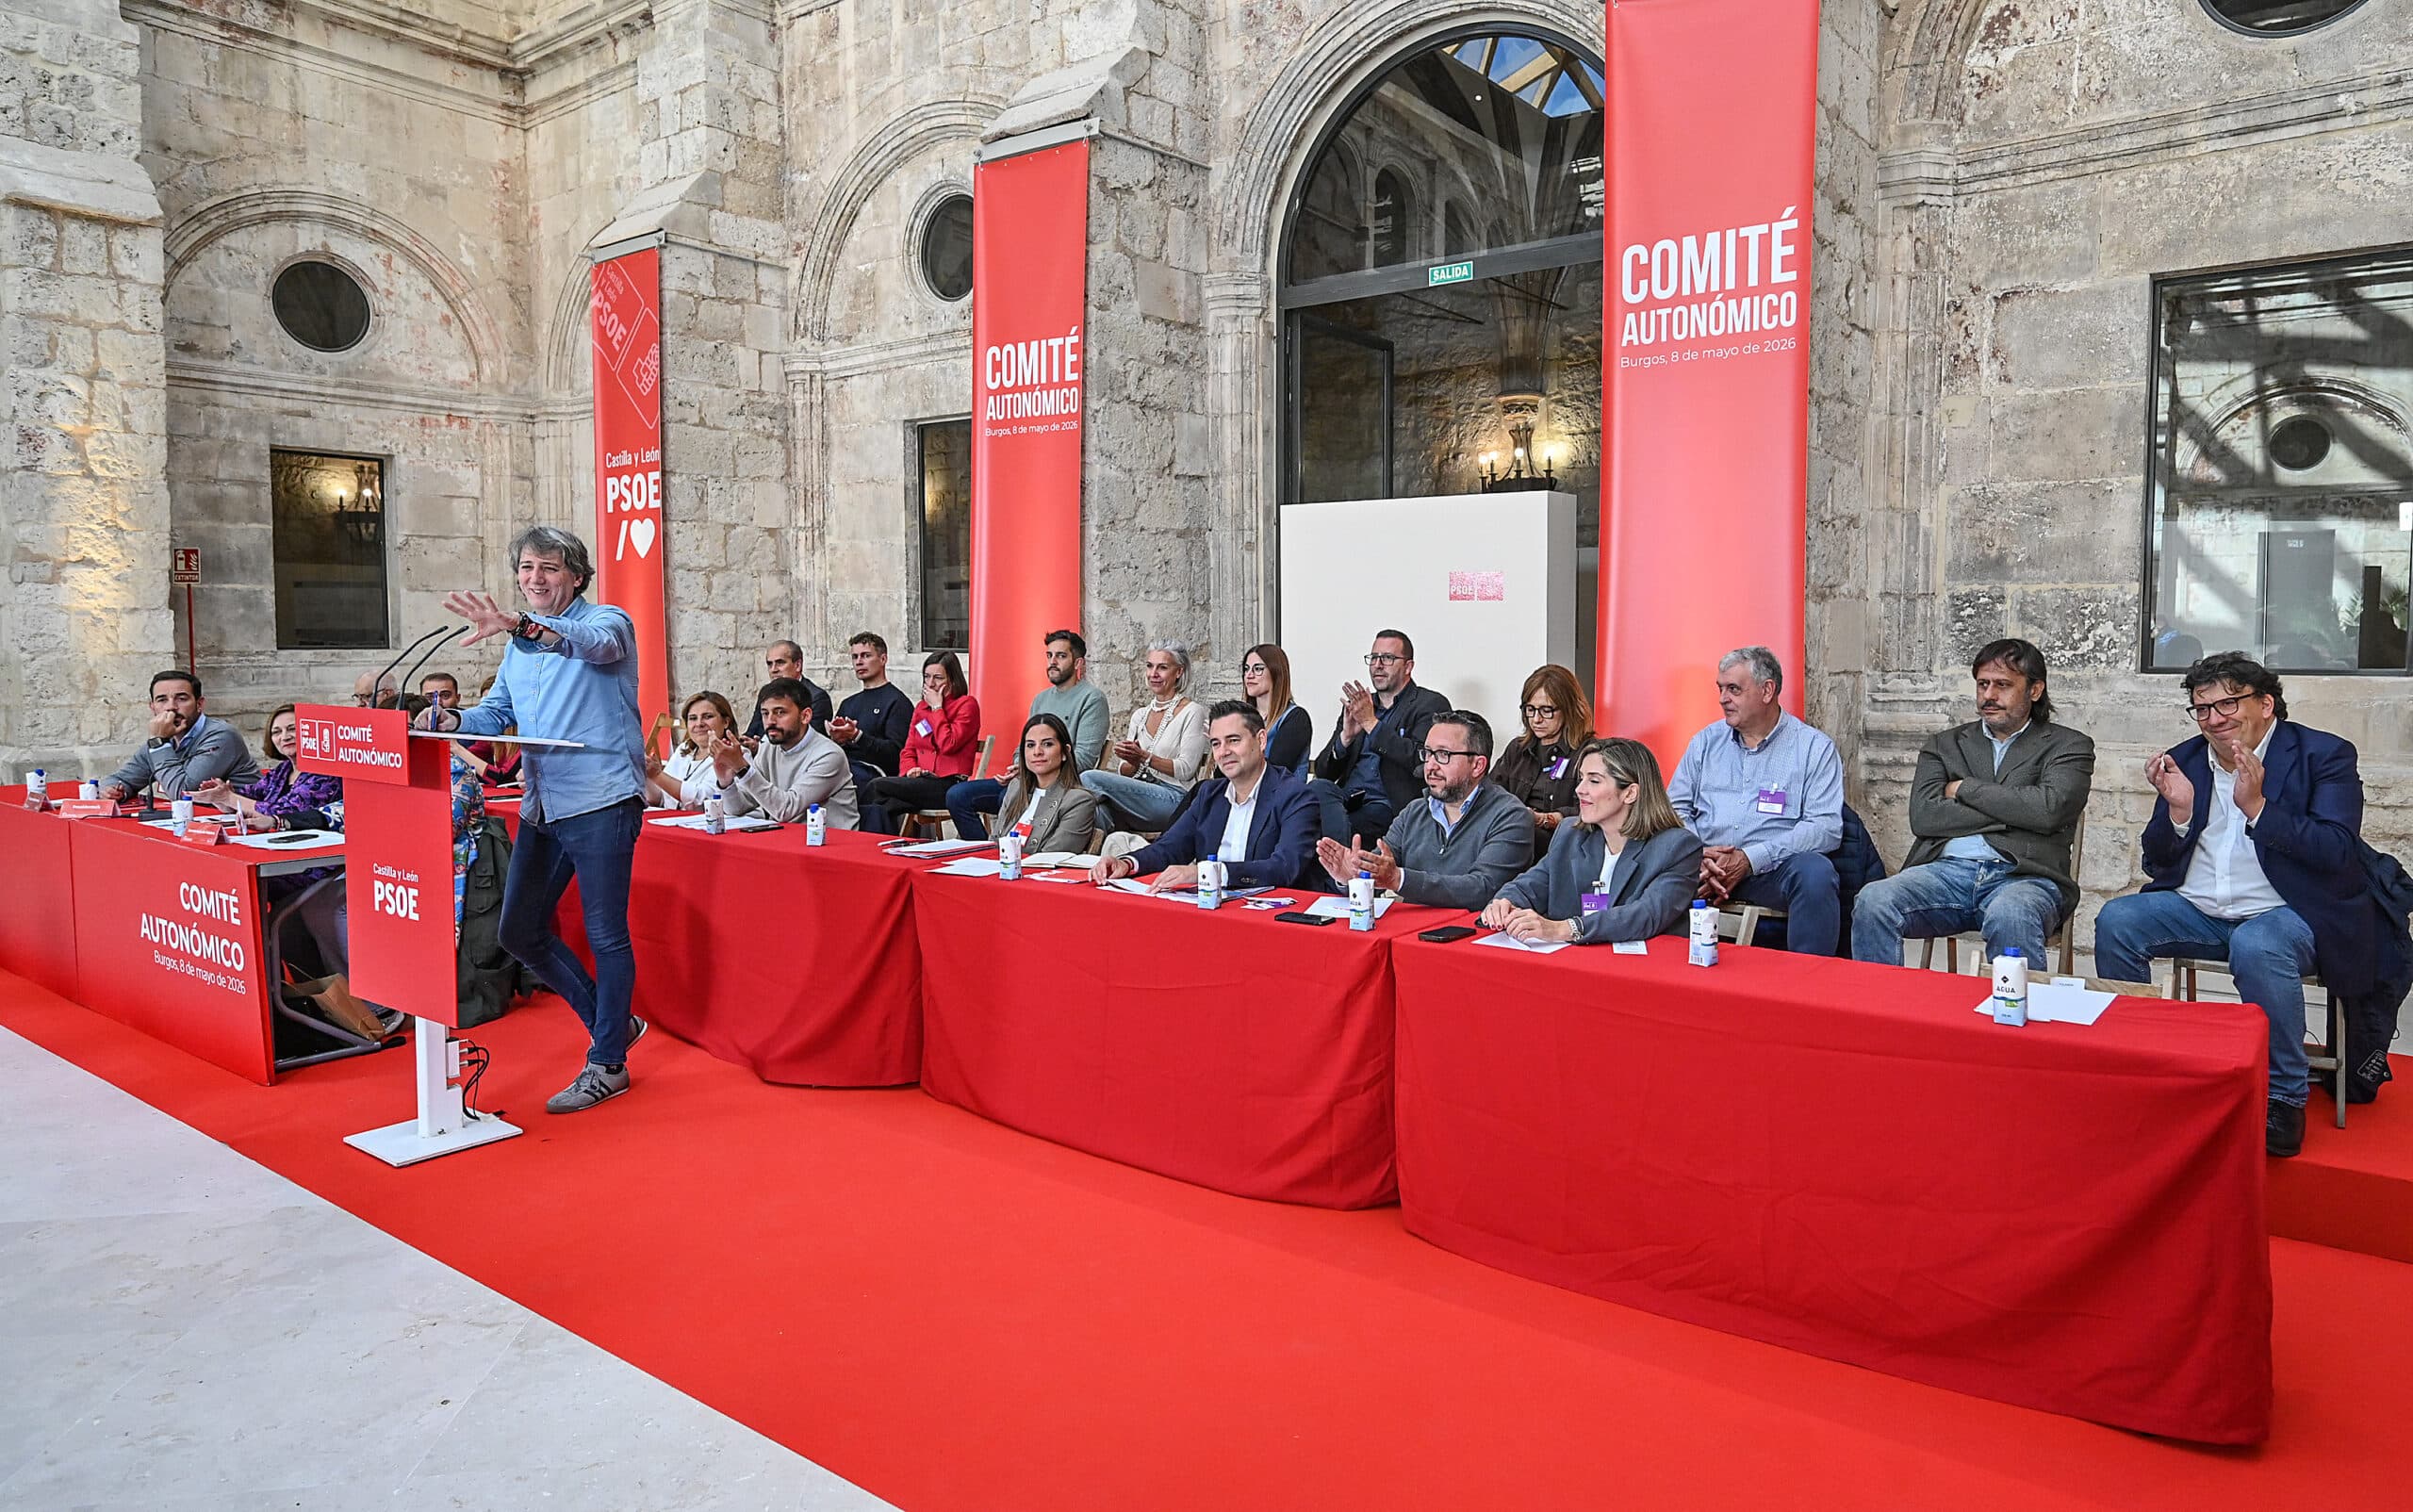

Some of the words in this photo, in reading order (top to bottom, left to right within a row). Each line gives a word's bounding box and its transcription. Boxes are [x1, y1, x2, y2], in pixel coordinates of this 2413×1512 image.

[1433, 265, 1469, 281] SALIDA
[1621, 205, 1798, 304] COMITÉ
[590, 289, 628, 352] PSOE
[1620, 290, 1797, 347] AUTONÓMICO
[985, 325, 1079, 390] COMITÉ
[1620, 353, 1668, 369] Burgos,
[1670, 351, 1680, 363] 8
[1682, 349, 1699, 361] de
[1702, 345, 1739, 359] mayo
[1742, 341, 1761, 354] de
[1764, 337, 1797, 353] 2026
[985, 386, 1078, 421] AUTONÓMICO
[985, 427, 1011, 437] Burgos,
[1012, 425, 1018, 434] 8
[1018, 424, 1027, 434] de
[1028, 424, 1049, 434] mayo
[1050, 421, 1060, 431] de
[1061, 419, 1078, 431] 2026
[605, 450, 632, 468] Castilla
[633, 452, 639, 468] y
[640, 446, 660, 464] León
[606, 470, 661, 514] PSOE
[302, 736, 317, 750] PSOE
[337, 724, 373, 743] COMITÉ
[337, 747, 402, 768] AUTONÓMICO
[372, 863, 397, 879] Castilla
[397, 870, 402, 881] y
[402, 868, 419, 883] León
[179, 881, 241, 926] COMITÉ
[373, 879, 420, 921] PSOE
[140, 912, 245, 972] AUTONÓMICO
[154, 949, 180, 973] Burgos,
[179, 959, 185, 973] 8
[186, 961, 195, 977] de
[195, 967, 216, 985] mayo
[216, 972, 227, 988] de
[226, 975, 247, 995] 2026
